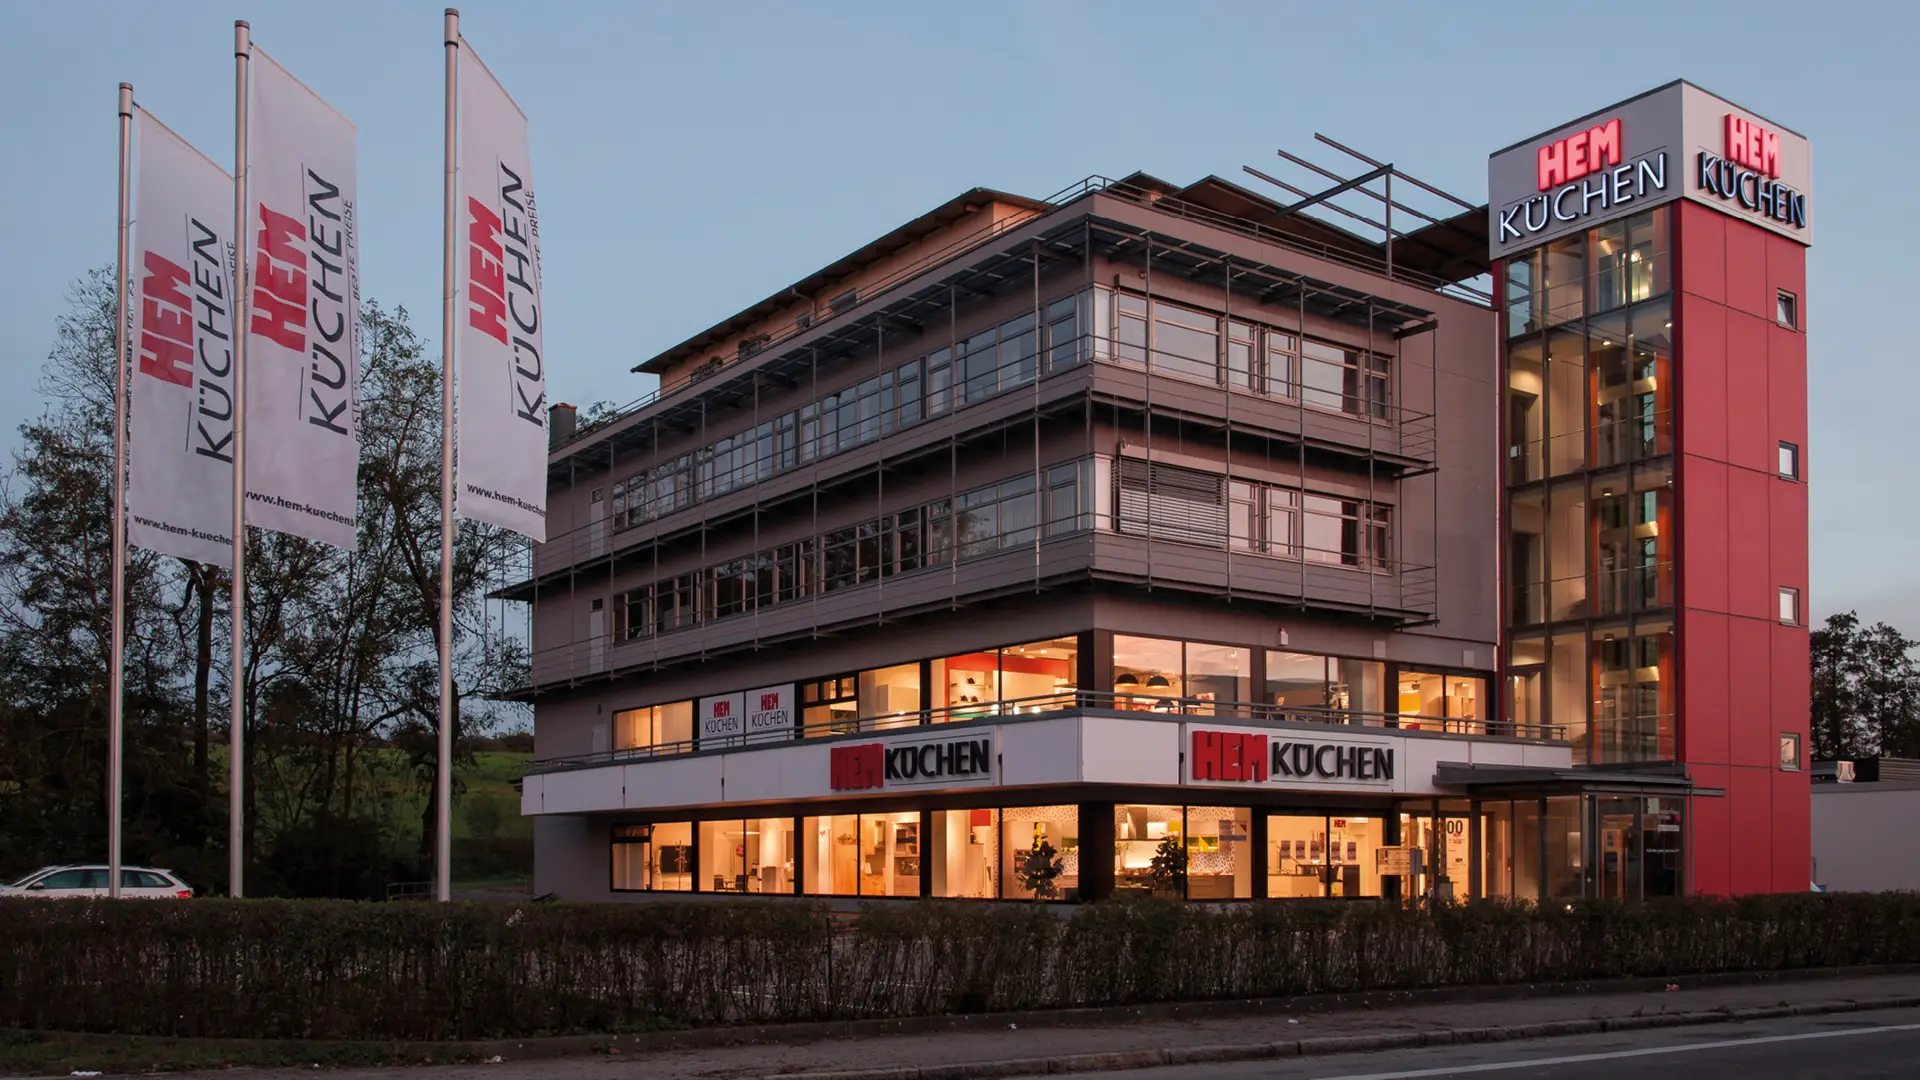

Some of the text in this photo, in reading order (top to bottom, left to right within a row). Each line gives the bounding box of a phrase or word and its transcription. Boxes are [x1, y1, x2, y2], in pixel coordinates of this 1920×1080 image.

[1538, 117, 1621, 191] HEM
[1726, 113, 1780, 179] HEM
[1499, 152, 1667, 244] KÜCHEN
[1697, 152, 1806, 229] KÜCHEN
[250, 202, 307, 353] HEM
[308, 168, 348, 436] KÜCHEN
[468, 195, 508, 346] HEM
[500, 160, 544, 427] KÜCHEN
[139, 250, 194, 388] HEM
[196, 217, 234, 464] KÜCHEN
[714, 700, 730, 719] HEM
[761, 692, 779, 711] HEM
[830, 739, 990, 791] HEM KÜCHEN
[1192, 730, 1394, 782] HEM KÜCHEN
